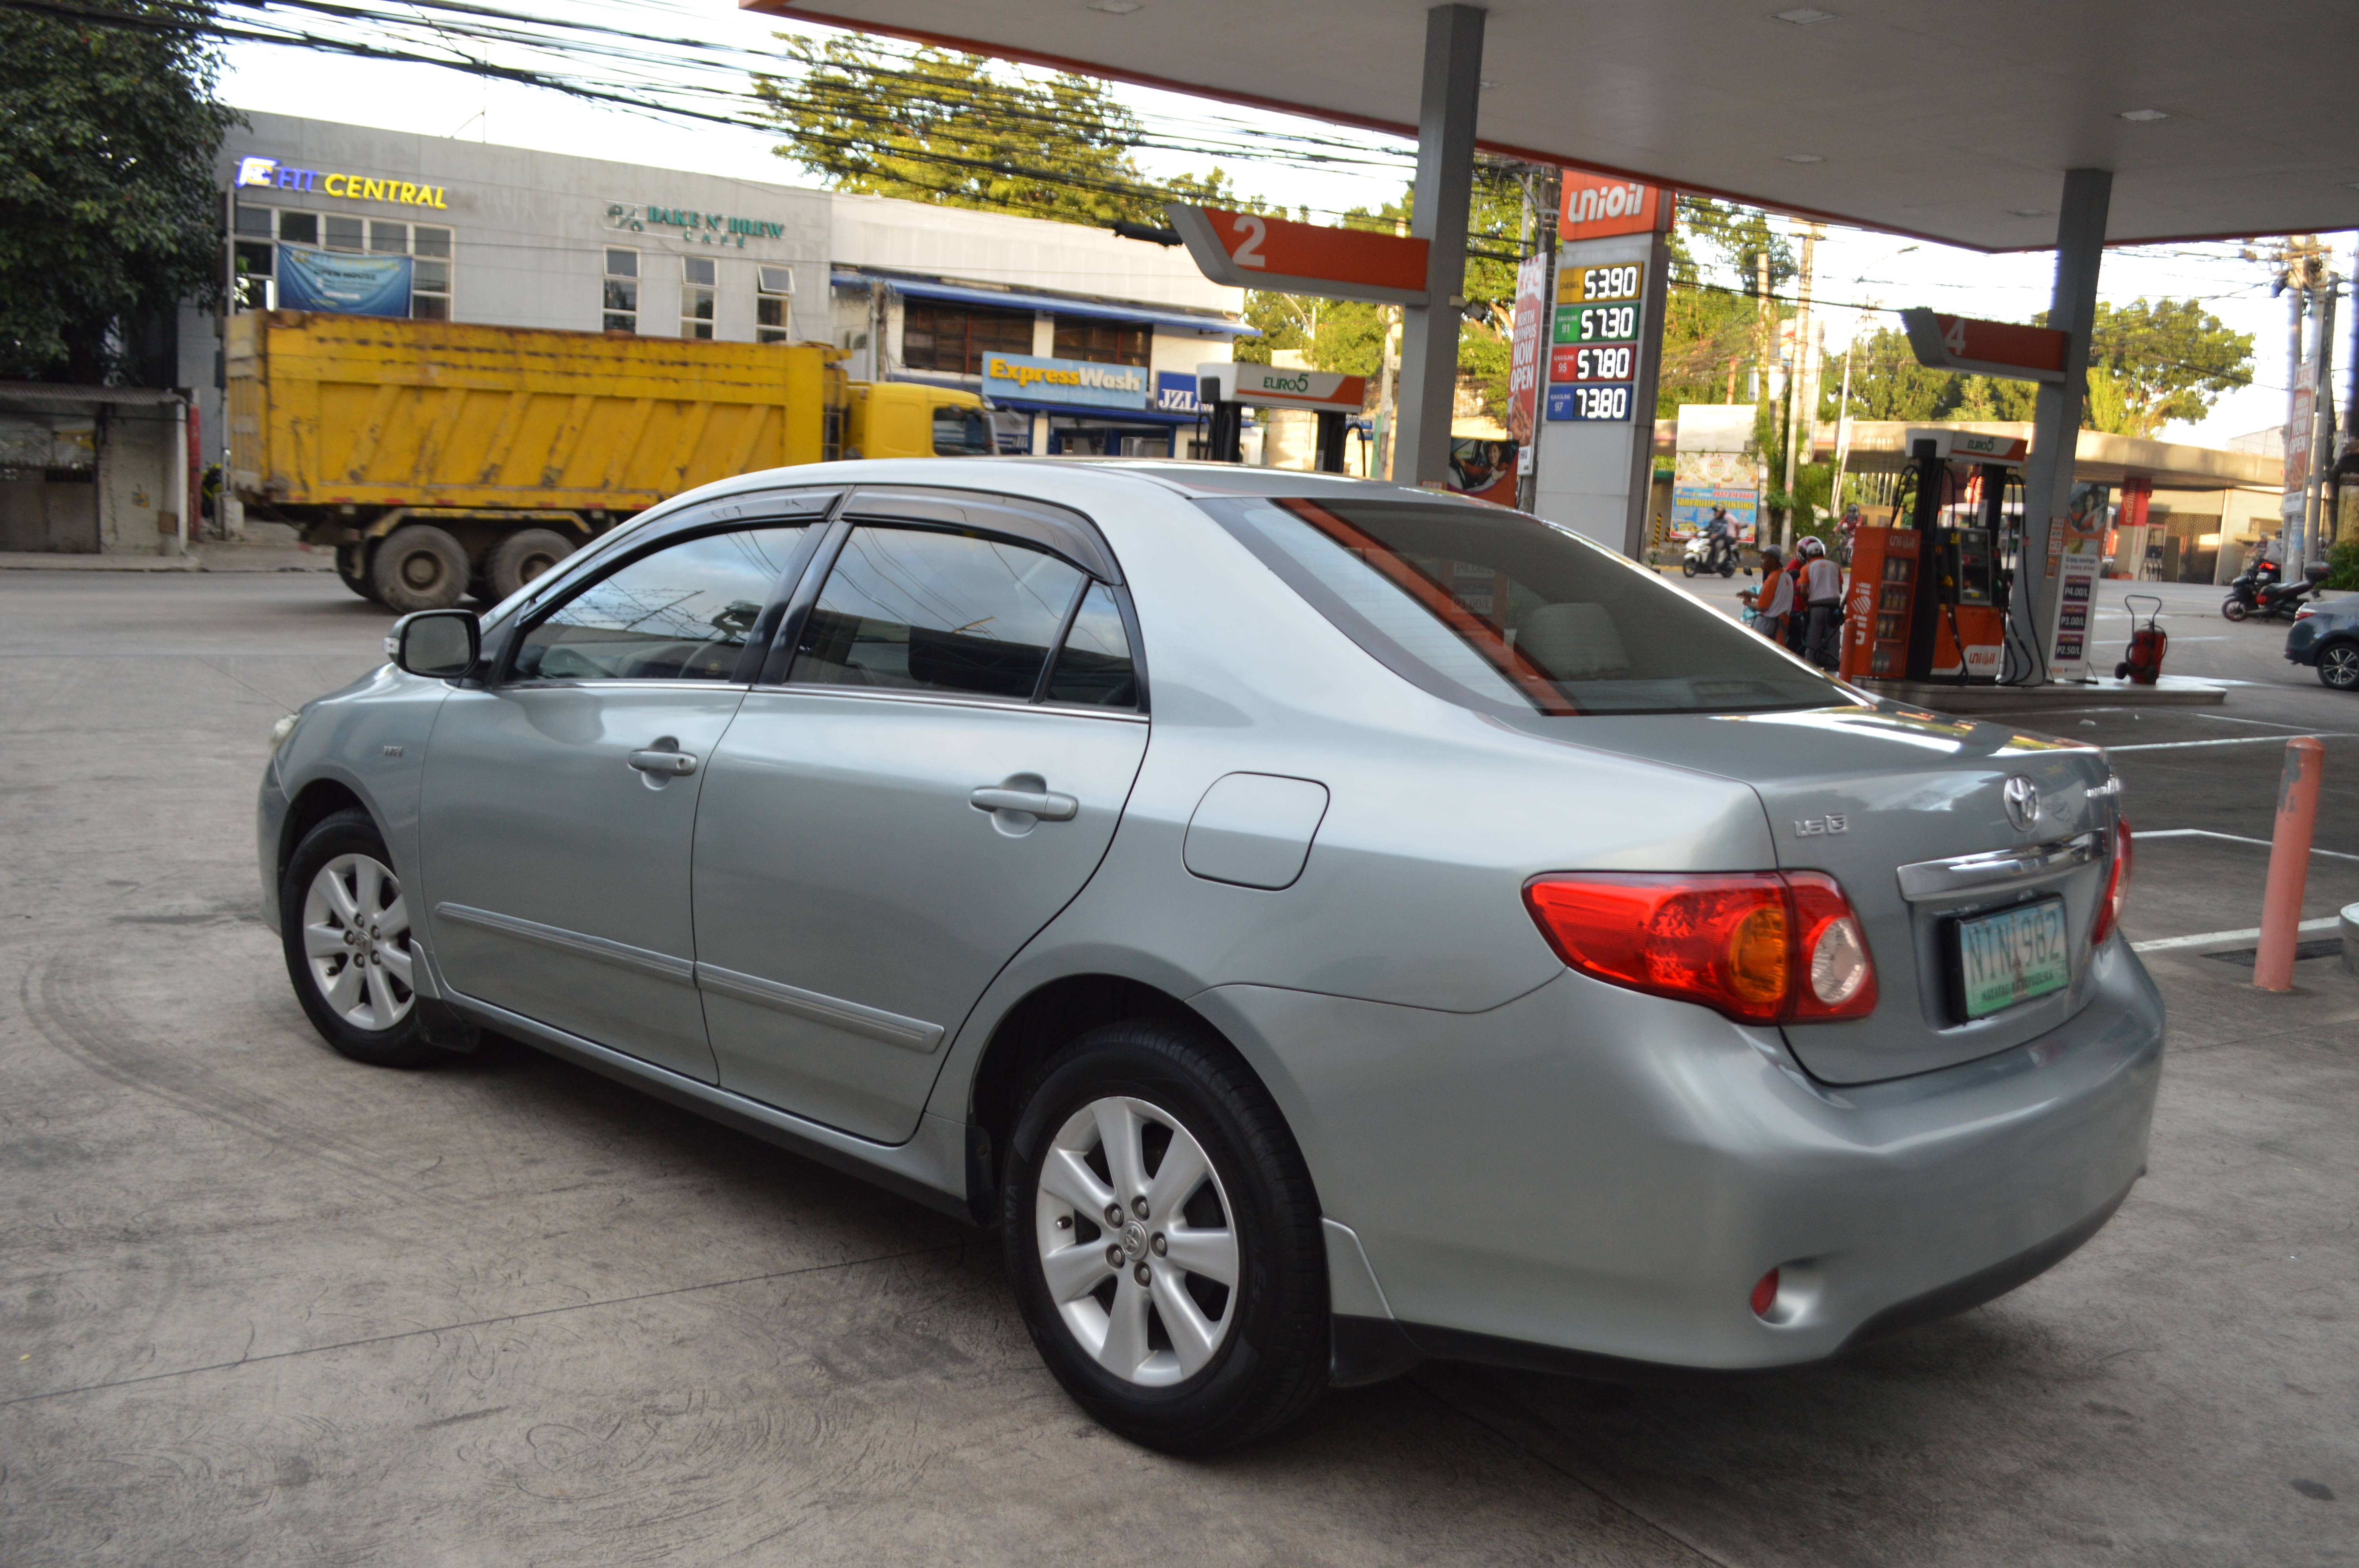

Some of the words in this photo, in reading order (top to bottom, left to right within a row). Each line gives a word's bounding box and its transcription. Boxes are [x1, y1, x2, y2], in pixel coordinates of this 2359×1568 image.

[277, 166, 318, 192] FIT
[325, 173, 447, 209] CENTRAL
[648, 206, 700, 228] BAKE
[729, 217, 785, 238] BREW
[683, 229, 744, 247] CAFE
[1232, 215, 1266, 268] 2
[1518, 265, 1541, 293] KFC
[1584, 266, 1637, 300] 53.90
[1517, 309, 1535, 327] NORTH
[1562, 323, 1570, 333] 91
[1581, 307, 1634, 339] 57.30
[1514, 323, 1537, 343] OLYMPUS
[1945, 317, 1965, 355] 4
[1513, 339, 1534, 367] NOW
[1578, 348, 1630, 379] 57.80
[1510, 364, 1534, 392] OPEN
[1558, 363, 1567, 373] 95
[2296, 368, 2312, 385] KFC
[1158, 388, 1199, 411] JZL
[1555, 402, 1563, 412] 97
[1576, 388, 1626, 419] 73.80
[2290, 435, 2306, 454] OPEN
[1676, 497, 1716, 507] TARPAULIN
